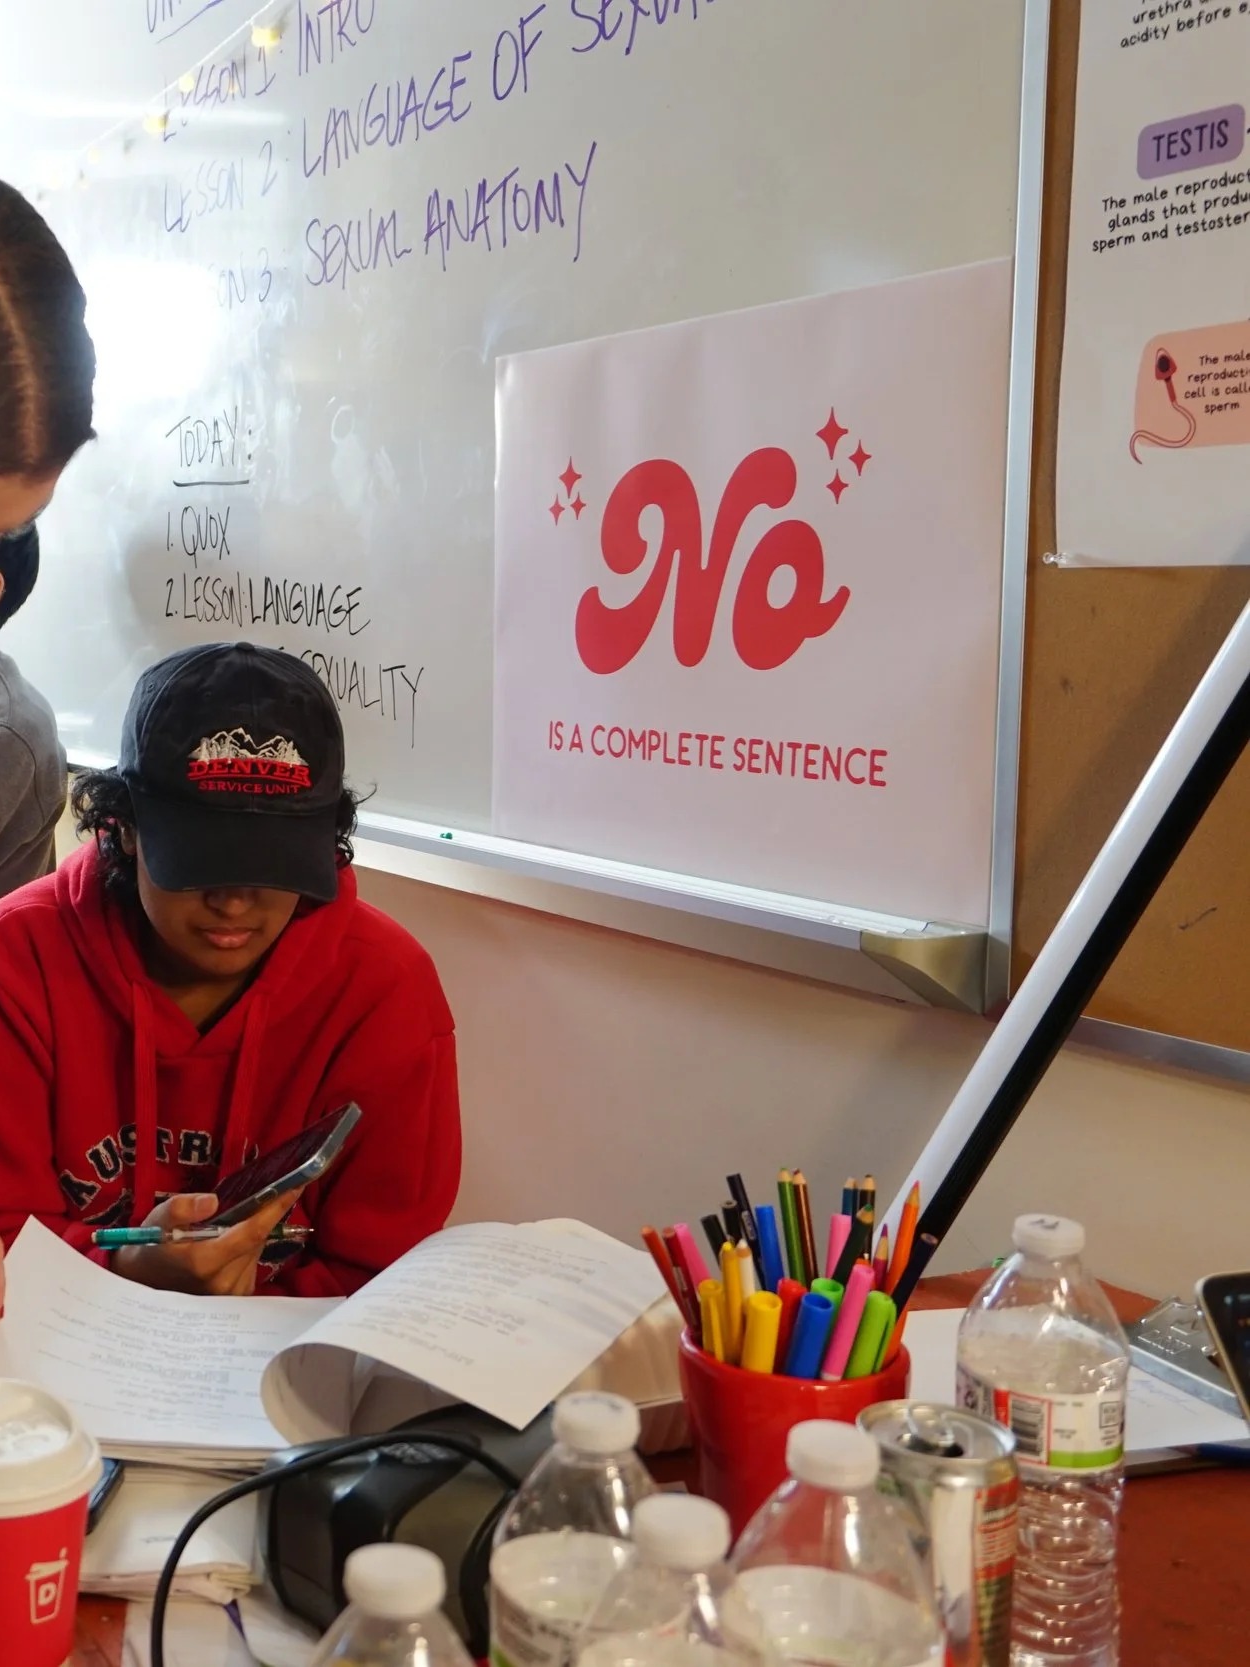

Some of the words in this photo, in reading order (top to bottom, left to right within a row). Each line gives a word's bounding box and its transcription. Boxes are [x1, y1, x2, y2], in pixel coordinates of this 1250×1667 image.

[1120, 25, 1170, 48] acidity
[1176, 6, 1232, 32] before
[164, 157, 244, 233] LESSON
[303, 50, 472, 178] LANGUAGE
[493, 4, 548, 101] OF
[1152, 118, 1229, 163] TESTIS
[305, 208, 412, 290] SEXUAL
[424, 141, 597, 271] ANATOMY
[1101, 196, 1127, 213] The
[1133, 185, 1169, 205] male
[1108, 207, 1155, 232] glands
[1162, 201, 1197, 220] that
[1204, 189, 1250, 214] produ
[1092, 234, 1136, 253] sperm
[1141, 223, 1169, 242] and
[1199, 353, 1219, 367] The
[1224, 348, 1250, 363] male
[1184, 386, 1206, 400] cell
[1211, 386, 1220, 397] is
[1204, 401, 1240, 415] sperm
[575, 447, 851, 675] No
[301, 650, 424, 749] EXUALITY
[549, 720, 565, 751] IS
[569, 723, 584, 753] A
[591, 724, 726, 770] COMPLETE
[732, 737, 888, 787] SENTENCE
[187, 758, 312, 788] DENVER
[199, 780, 263, 794] SERVICE
[265, 784, 300, 795] UNIT
[37, 1581, 57, 1607] D
